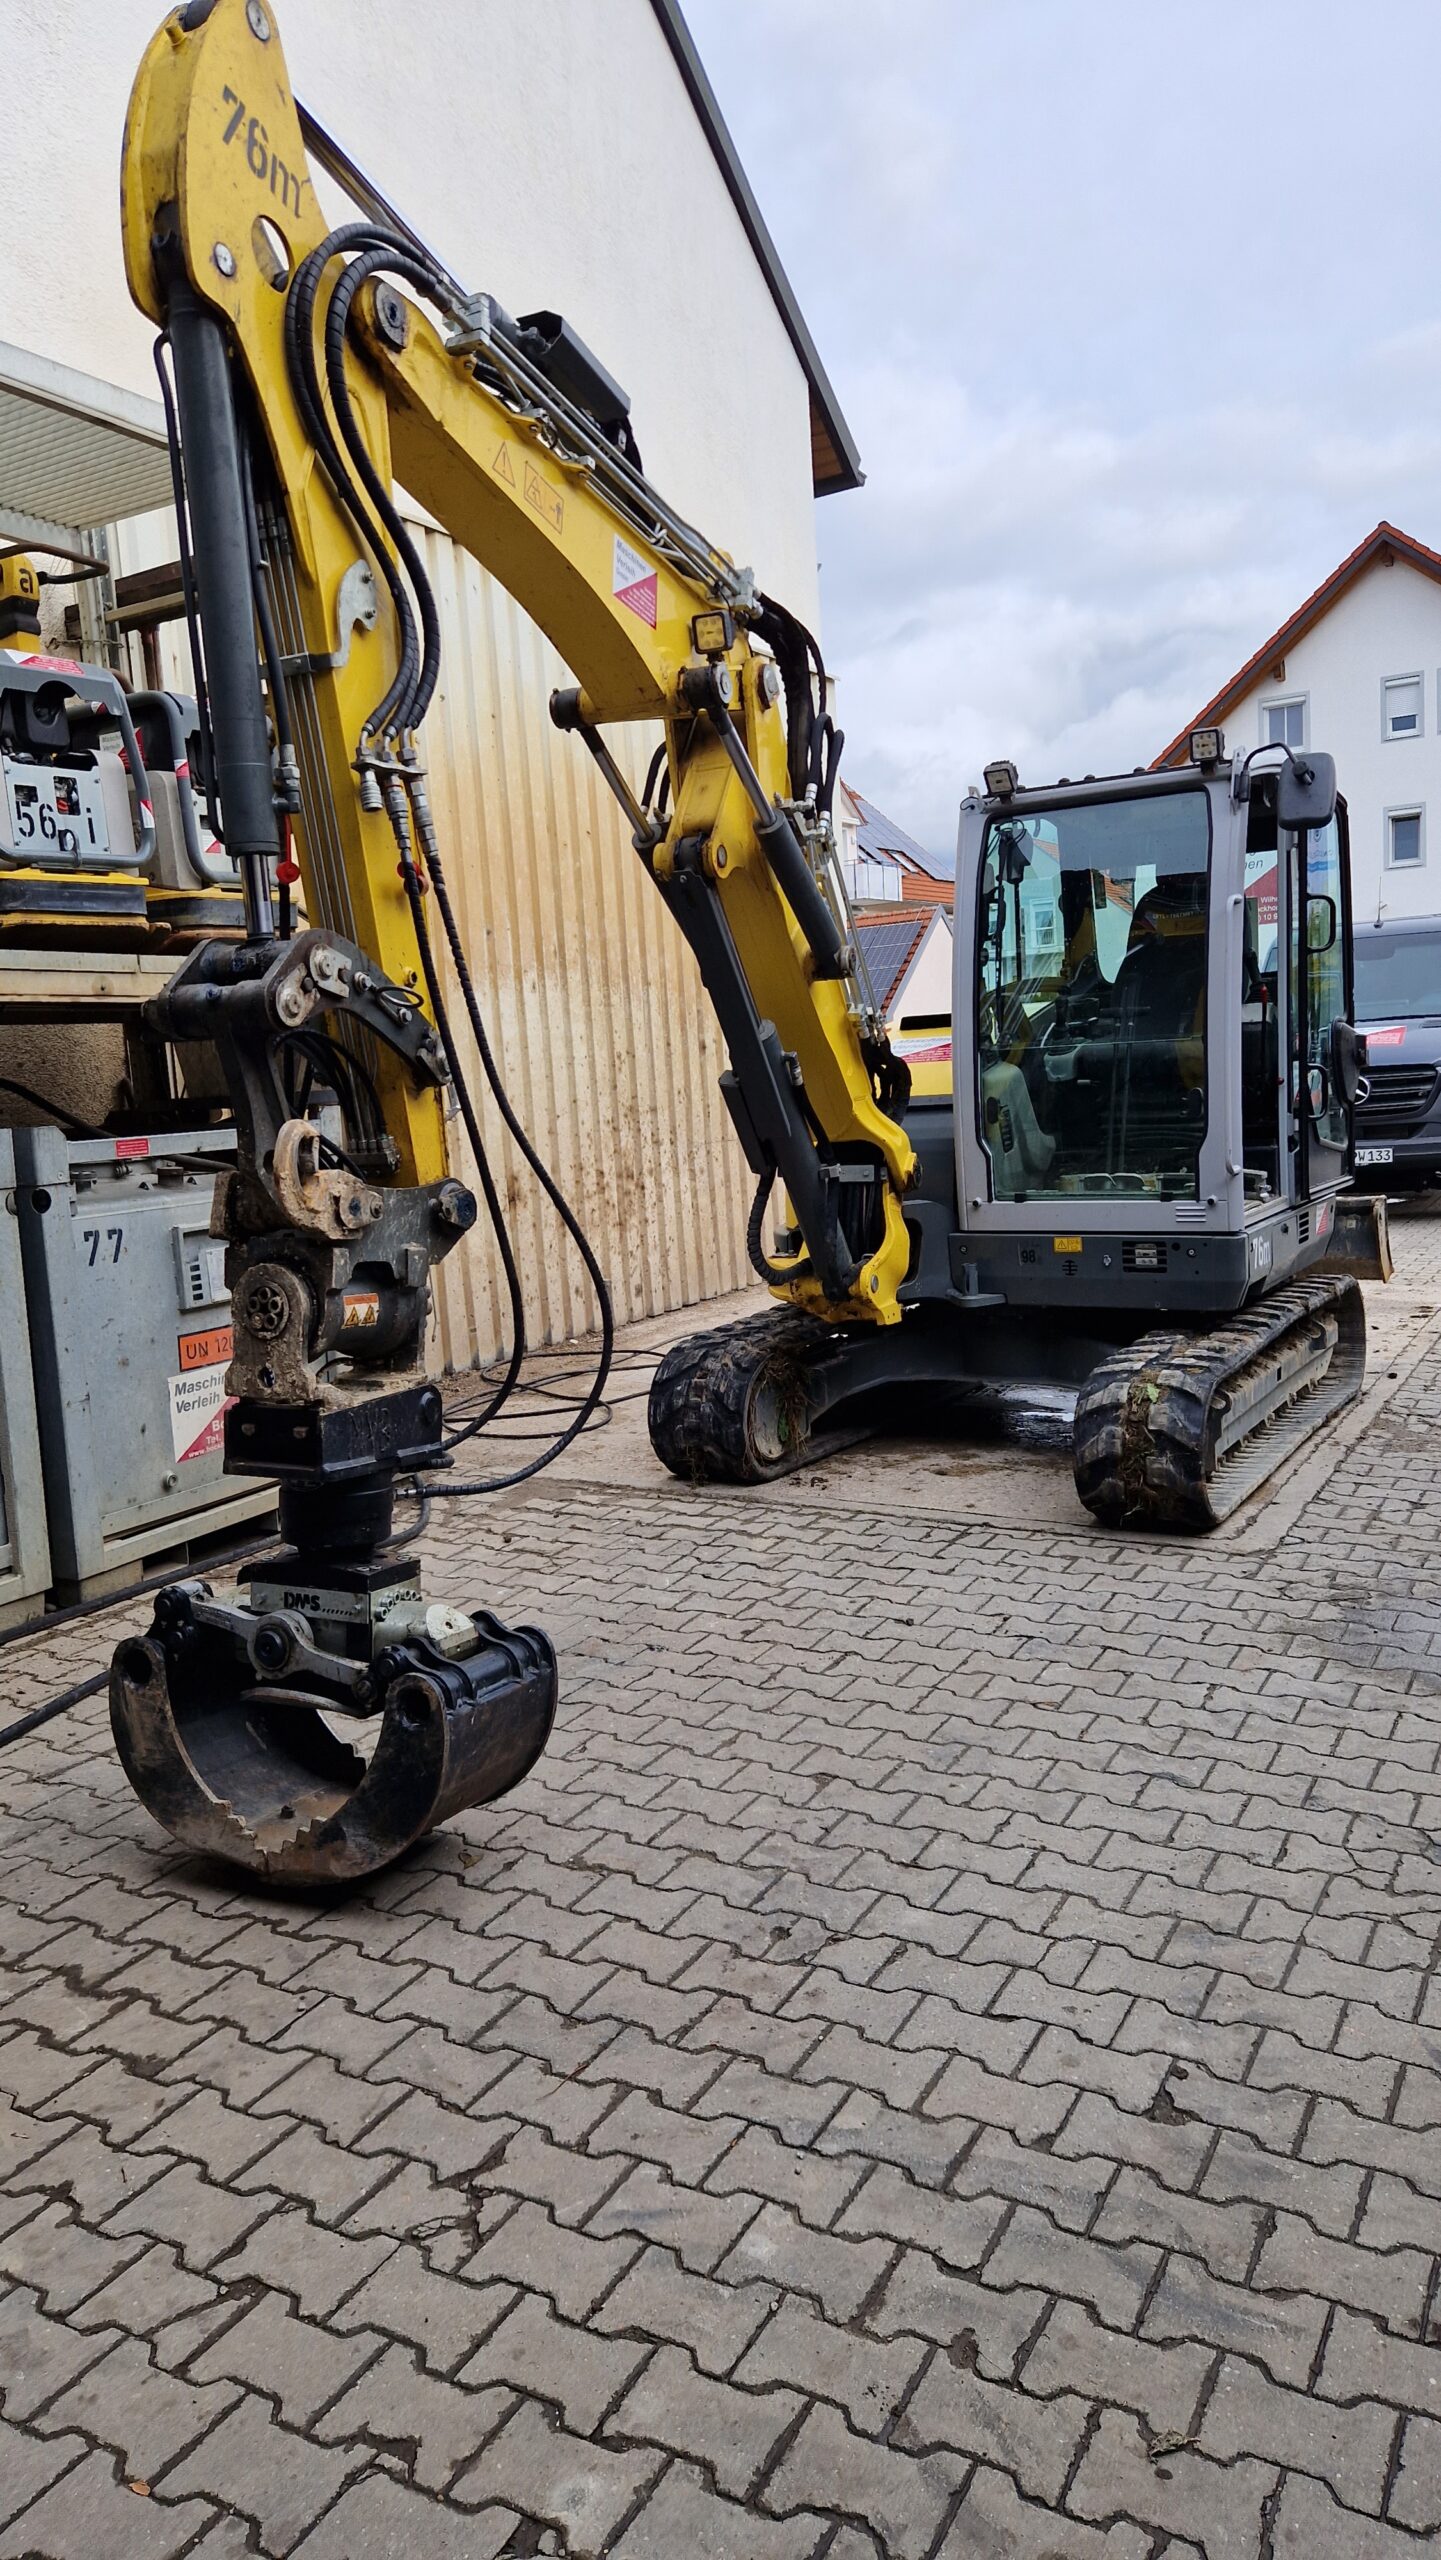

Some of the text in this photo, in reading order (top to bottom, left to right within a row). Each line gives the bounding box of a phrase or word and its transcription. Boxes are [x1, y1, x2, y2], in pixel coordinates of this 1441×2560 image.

[222, 84, 301, 219] 76m
[1367, 1150, 1391, 1162] 133
[83, 1228, 123, 1267] 77
[1020, 1249, 1036, 1264] 98
[1252, 1235, 1271, 1270] 76m
[186, 1341, 209, 1360] UN
[176, 1391, 220, 1414] Verleih
[205, 1434, 221, 1445] Tel.
[283, 1591, 321, 1612] DMS
